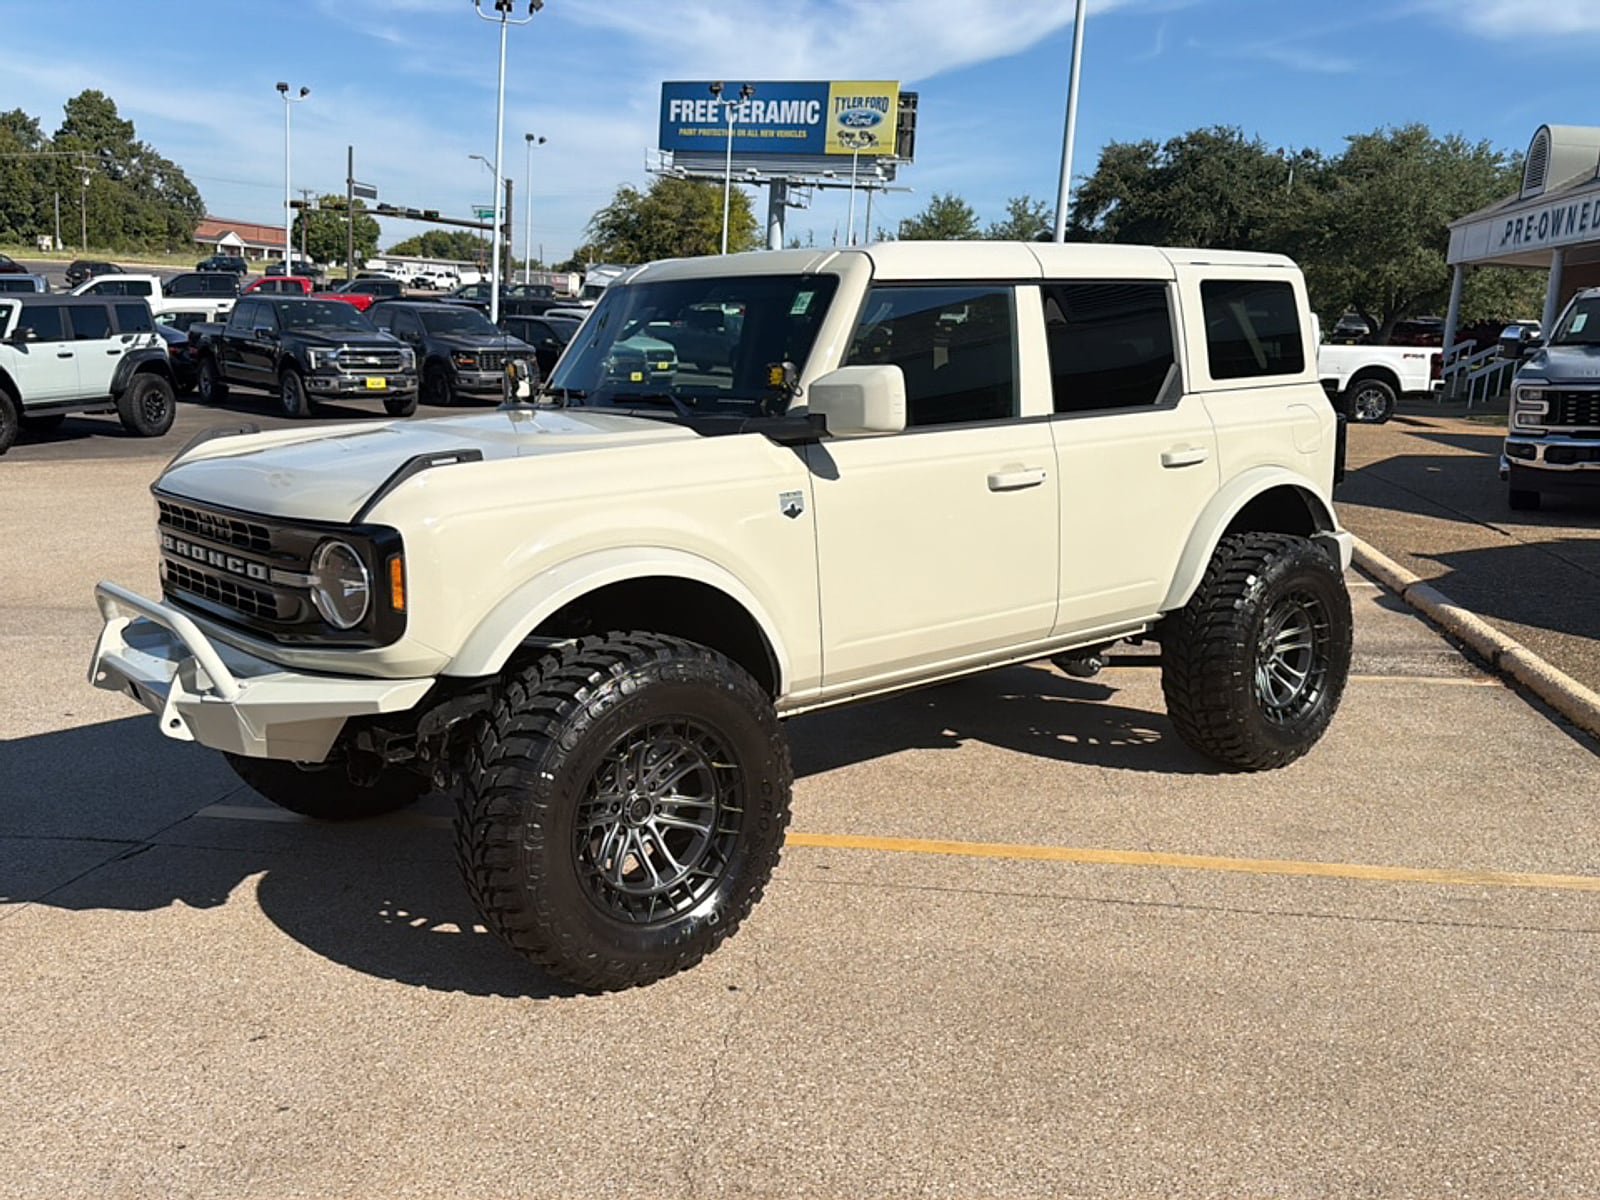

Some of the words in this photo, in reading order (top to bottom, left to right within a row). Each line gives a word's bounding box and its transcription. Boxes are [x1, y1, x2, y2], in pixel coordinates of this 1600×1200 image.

[669, 99, 719, 123] FREE
[725, 99, 820, 124] CERAMIC
[835, 96, 863, 114] TYLER
[865, 96, 889, 113] FORD
[1499, 199, 1600, 247] PRE-OWNED
[162, 535, 268, 580] BRONCO
